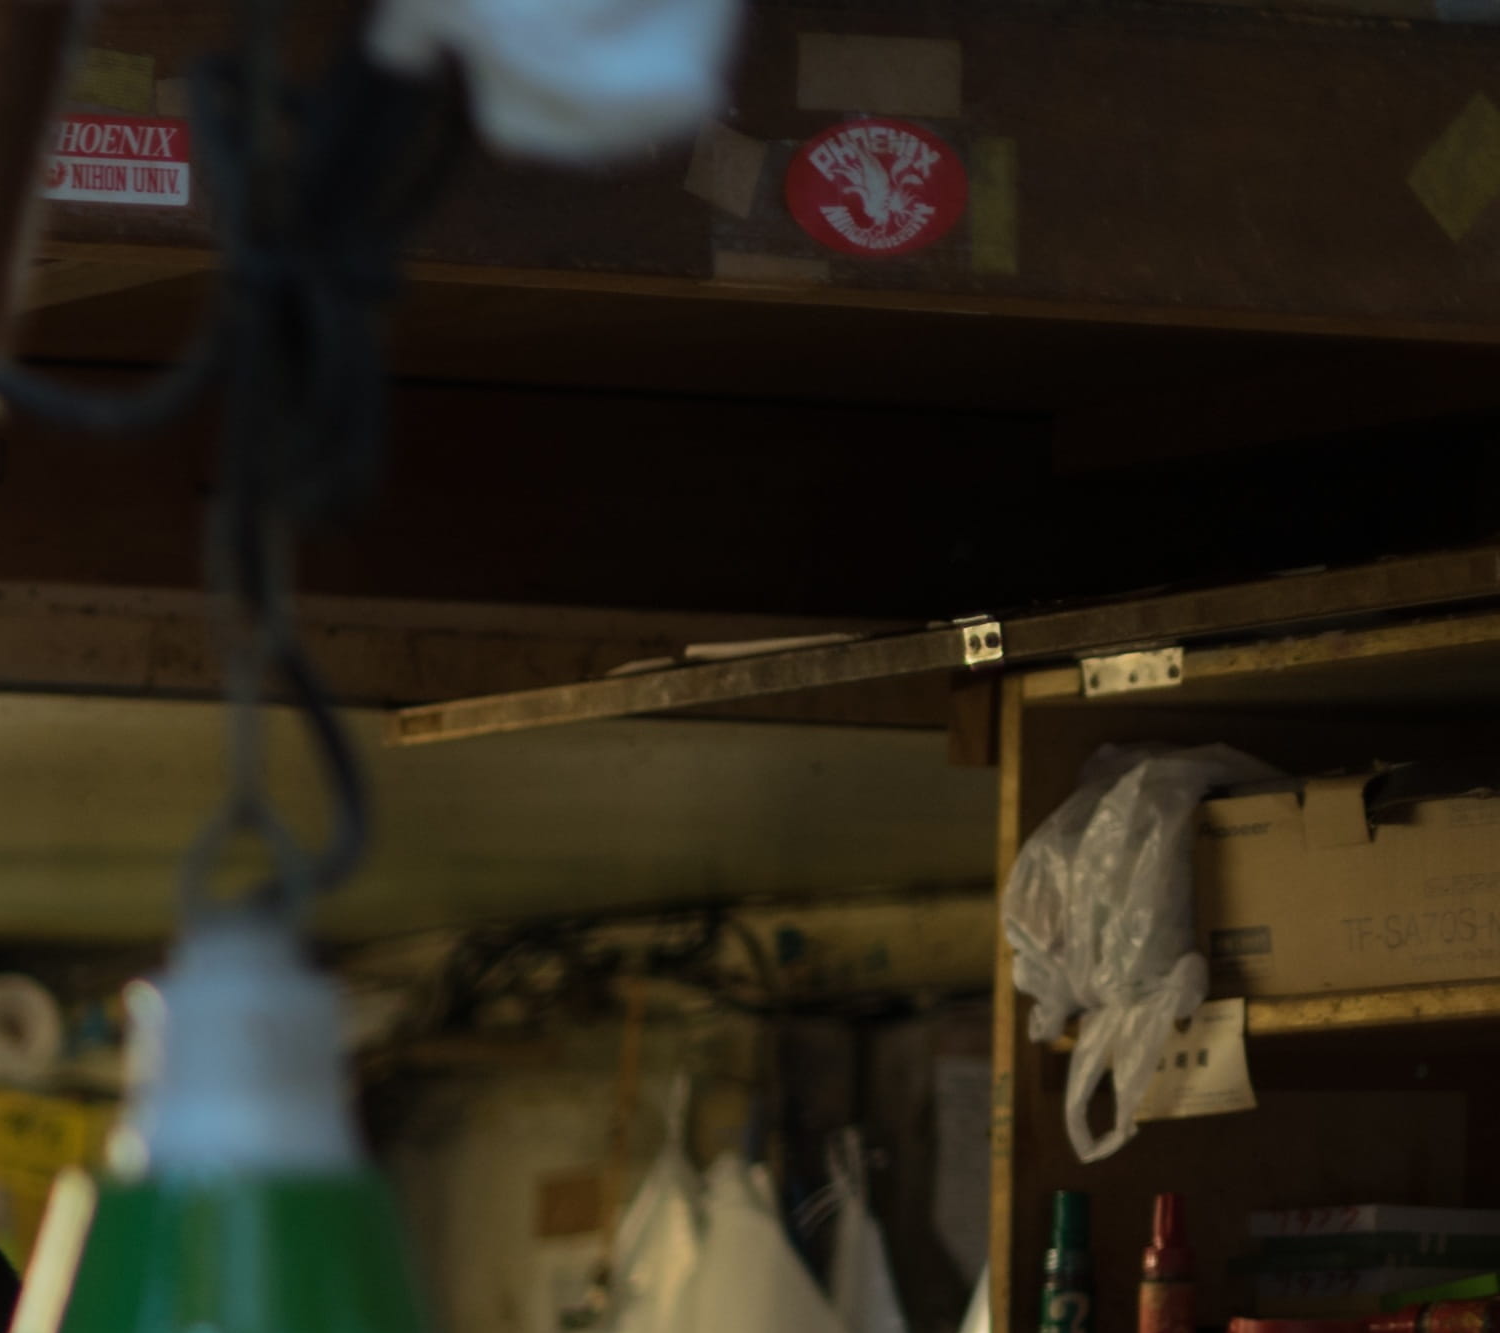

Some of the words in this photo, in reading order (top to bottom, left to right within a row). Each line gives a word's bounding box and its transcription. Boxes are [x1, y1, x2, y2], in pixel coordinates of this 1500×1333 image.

[56, 121, 179, 158] HOENIX
[71, 163, 127, 192] NIHON
[133, 167, 181, 195] UNIV.
